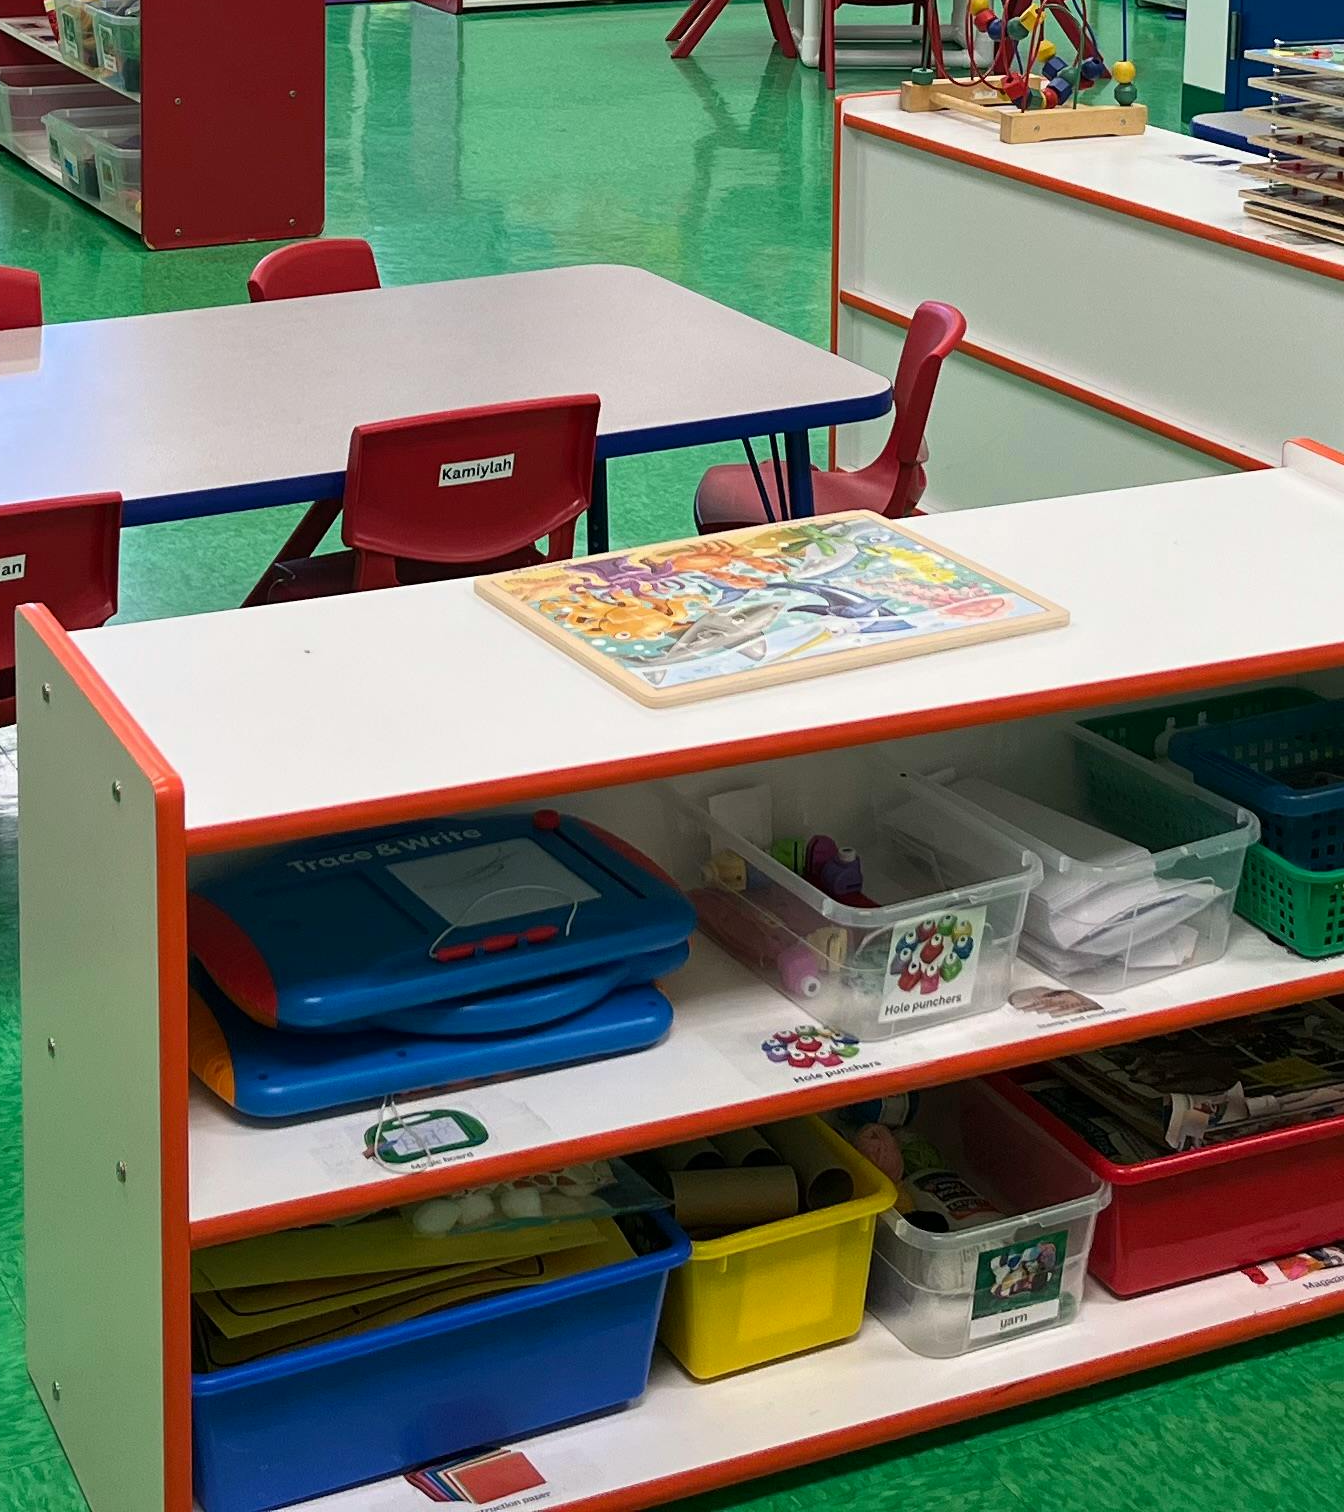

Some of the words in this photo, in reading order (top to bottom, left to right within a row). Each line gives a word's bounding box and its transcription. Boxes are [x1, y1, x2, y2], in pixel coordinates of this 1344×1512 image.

[442, 458, 512, 480] Kamiylah
[287, 850, 373, 873] Trace
[375, 841, 402, 857] &
[399, 828, 482, 850] Write
[884, 1002, 910, 1016] Hole
[911, 992, 962, 1013] punchers
[793, 1070, 824, 1084] Hole
[826, 1059, 882, 1080] punchers
[443, 1151, 474, 1162] board
[1000, 1312, 1028, 1331] yarn
[522, 1490, 552, 1505] paper
